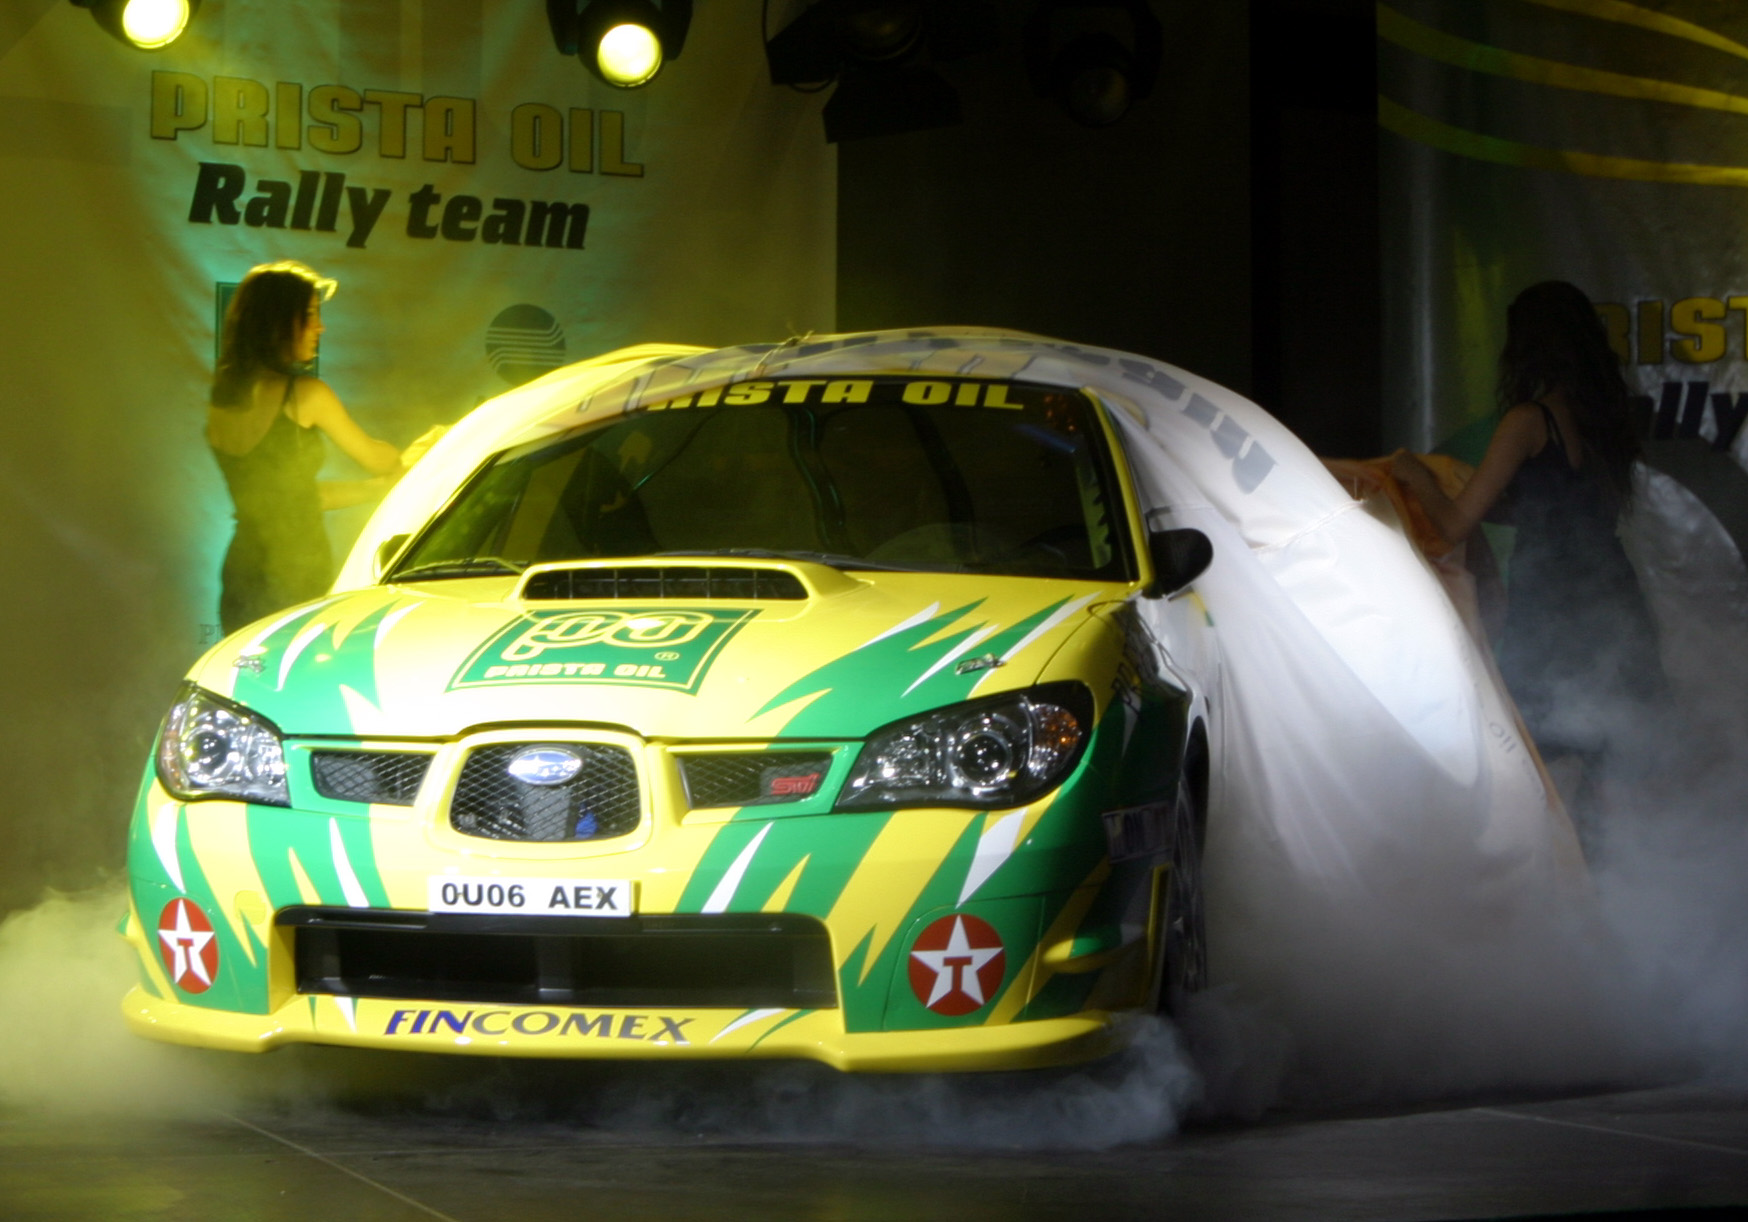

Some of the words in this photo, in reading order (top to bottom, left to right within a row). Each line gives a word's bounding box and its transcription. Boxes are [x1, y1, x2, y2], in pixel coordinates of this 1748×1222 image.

[150, 70, 477, 165] PRISTA
[510, 102, 645, 178] OIL
[188, 162, 392, 249] Rally
[405, 183, 591, 249] team
[646, 379, 874, 411] ISTA
[901, 382, 1024, 410] OIL
[483, 663, 606, 679] PRISTA
[613, 664, 666, 679] OIL
[548, 885, 618, 910] AEX
[384, 1009, 697, 1043] FINCOMEX
